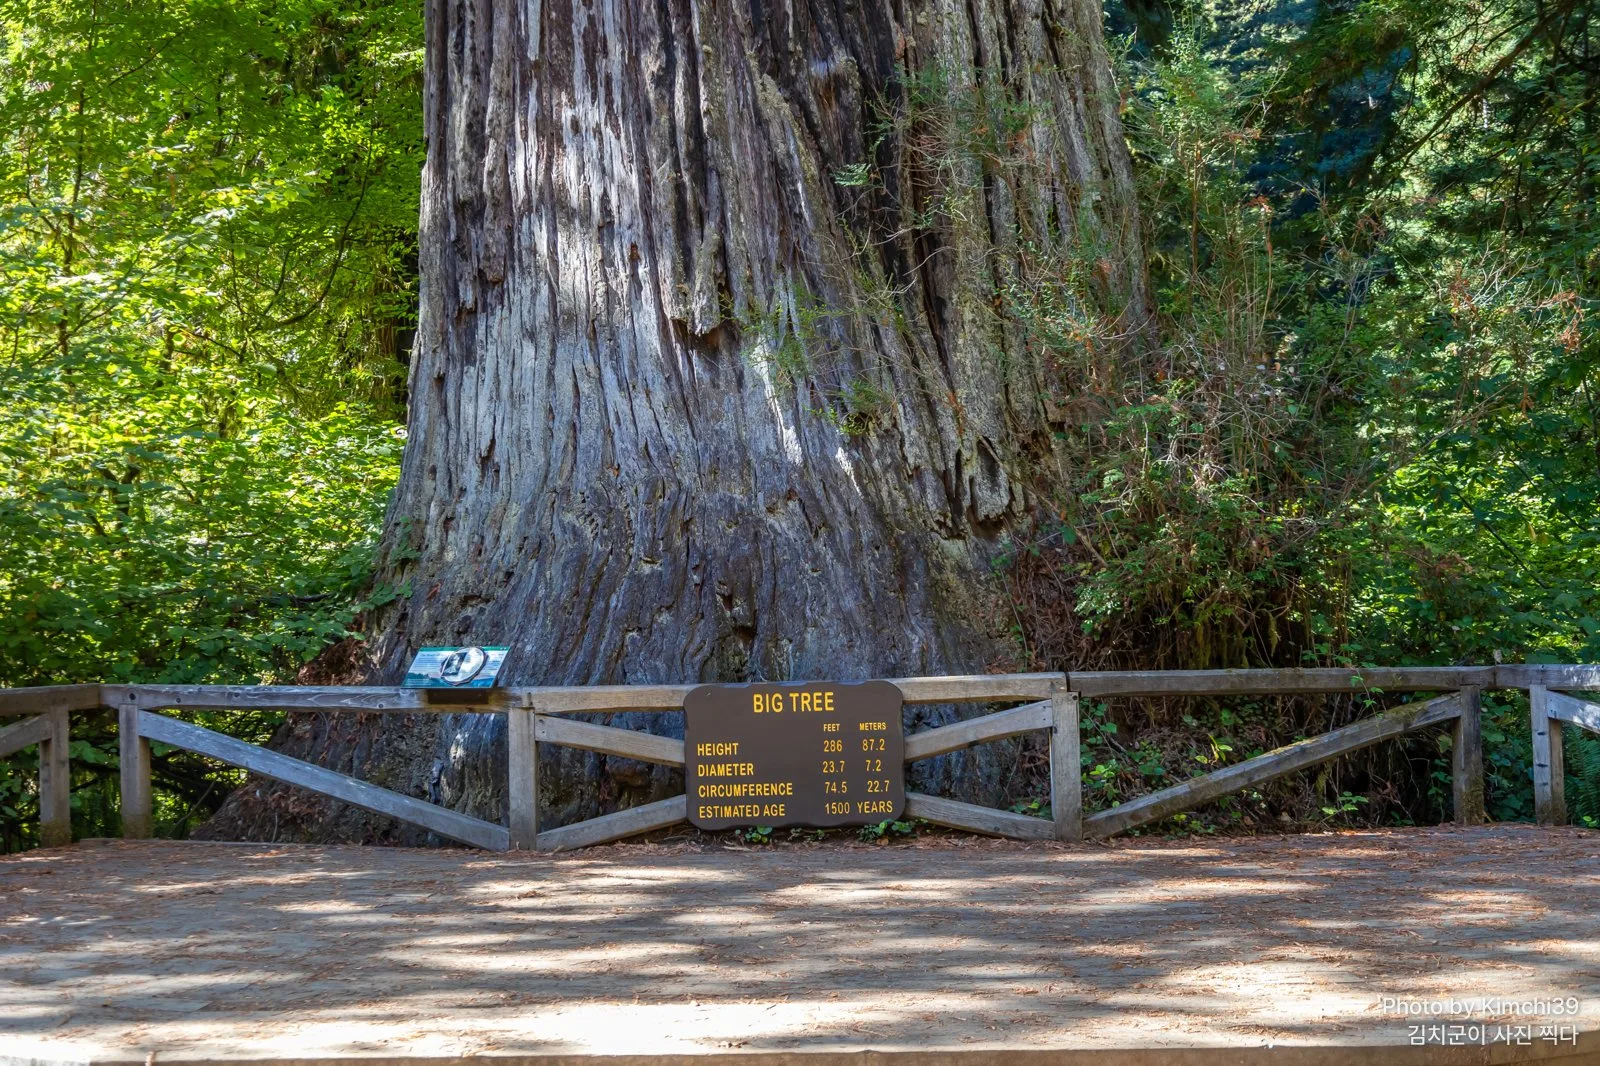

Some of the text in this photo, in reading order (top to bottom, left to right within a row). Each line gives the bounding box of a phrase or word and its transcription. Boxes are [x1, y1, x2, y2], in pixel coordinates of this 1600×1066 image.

[753, 691, 834, 713] BIG TREE
[823, 722, 886, 732] FEET METERS
[697, 738, 885, 756] HEIGHT 286 87.2
[698, 759, 881, 777] DIAMETER 23.7 7.2
[698, 780, 890, 798] CIRCUMFERENCE 74.5 22.7
[699, 800, 893, 818] ESTIMATED AGE 1500 YEARS
